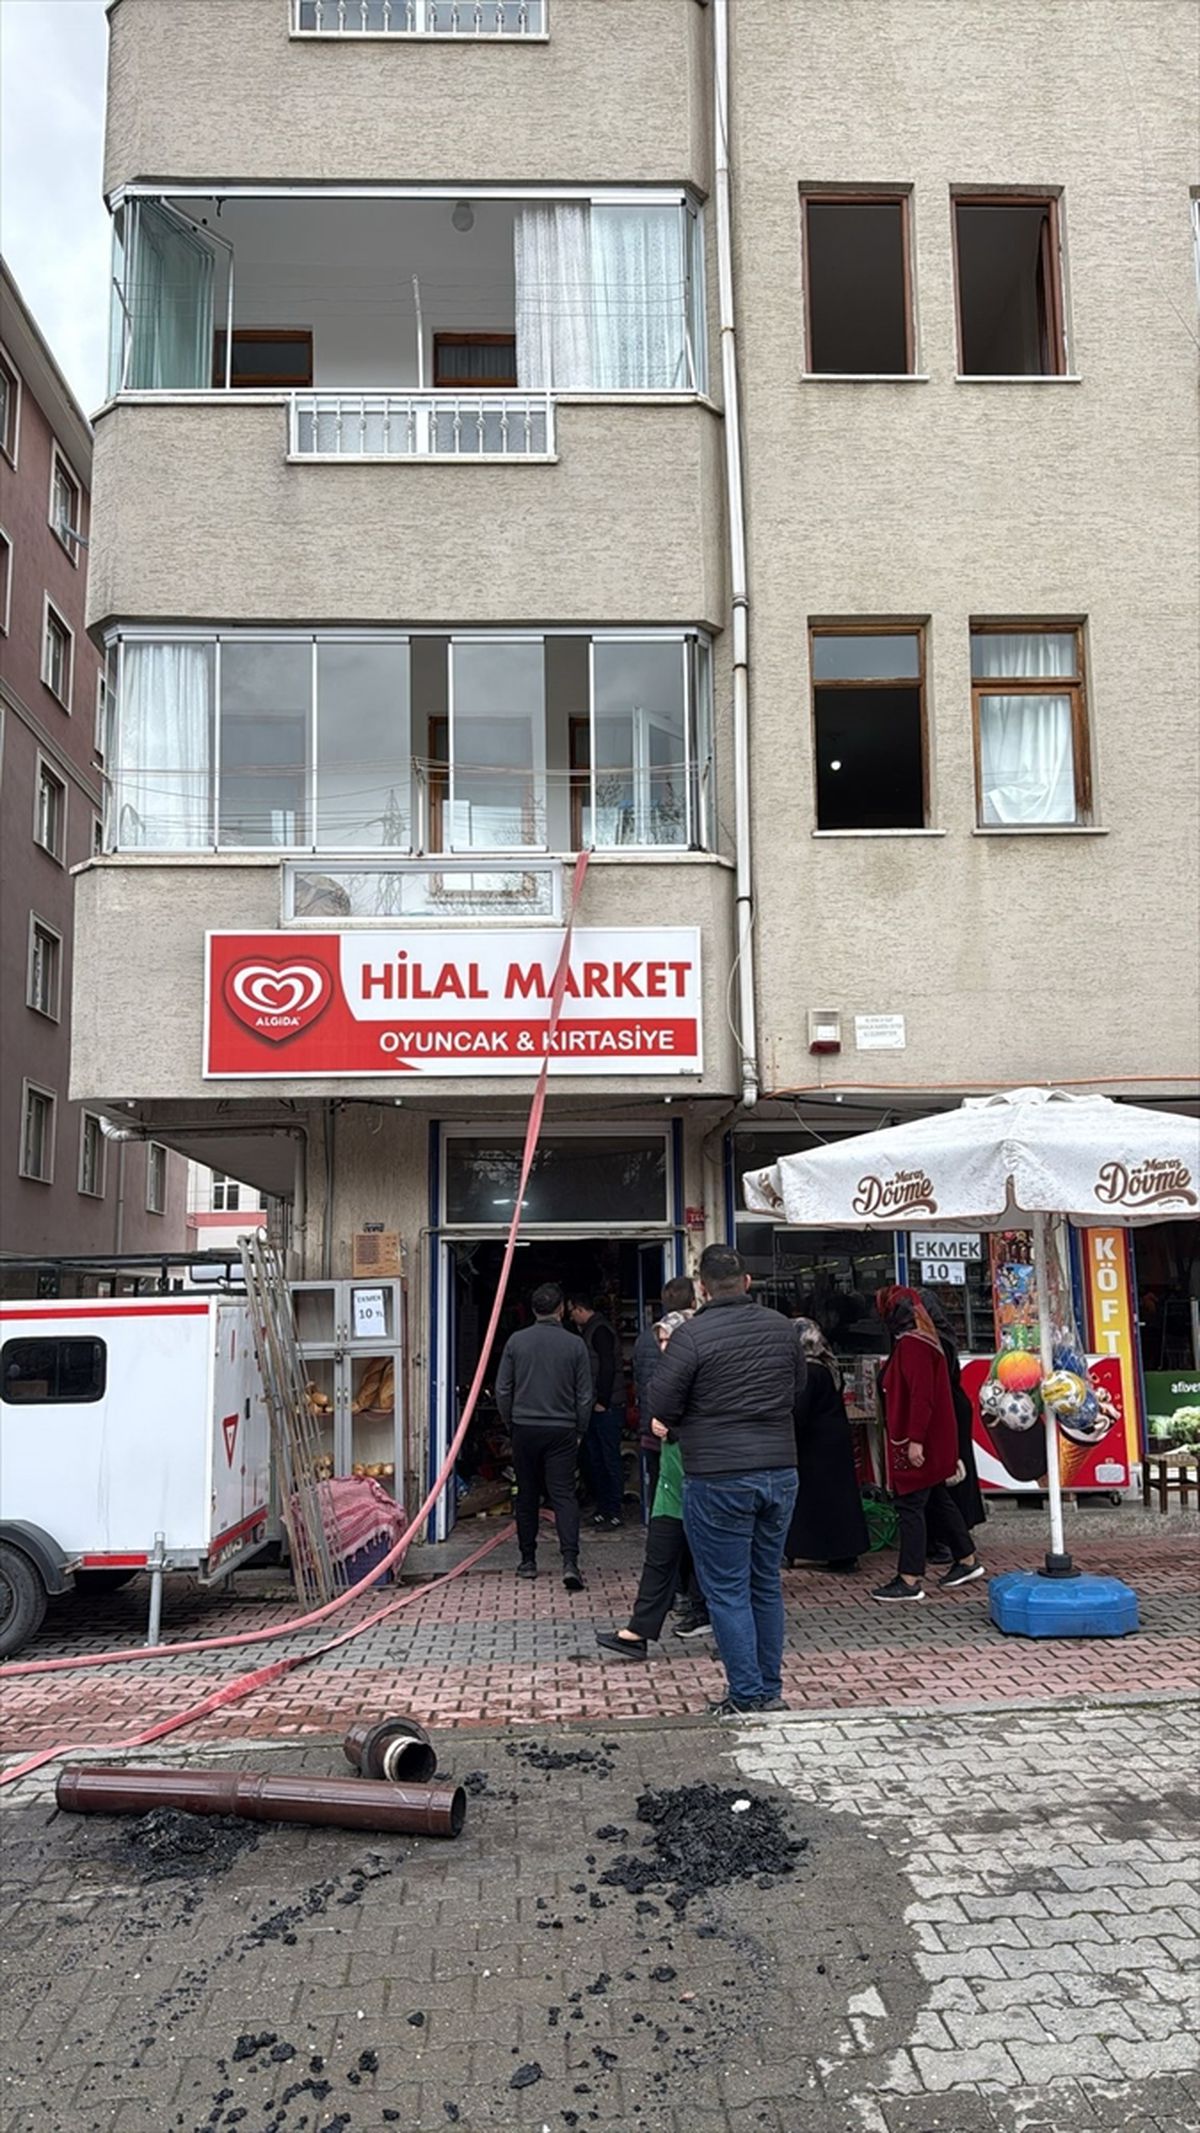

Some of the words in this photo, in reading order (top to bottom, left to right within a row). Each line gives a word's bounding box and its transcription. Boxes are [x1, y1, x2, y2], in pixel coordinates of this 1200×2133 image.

[361, 950, 489, 999] HİLAL
[504, 962, 692, 999] MARKET
[255, 1016, 300, 1027] ALGIDA
[379, 1031, 508, 1053] OYUNCAK
[516, 1031, 536, 1052] &
[542, 1024, 675, 1050] KIRTASİYE
[1094, 1161, 1192, 1205] Dövme
[852, 1175, 934, 1216] Dövme
[914, 1241, 980, 1257] EKMEK
[926, 1263, 949, 1280] 10
[359, 1307, 373, 1320] 10
